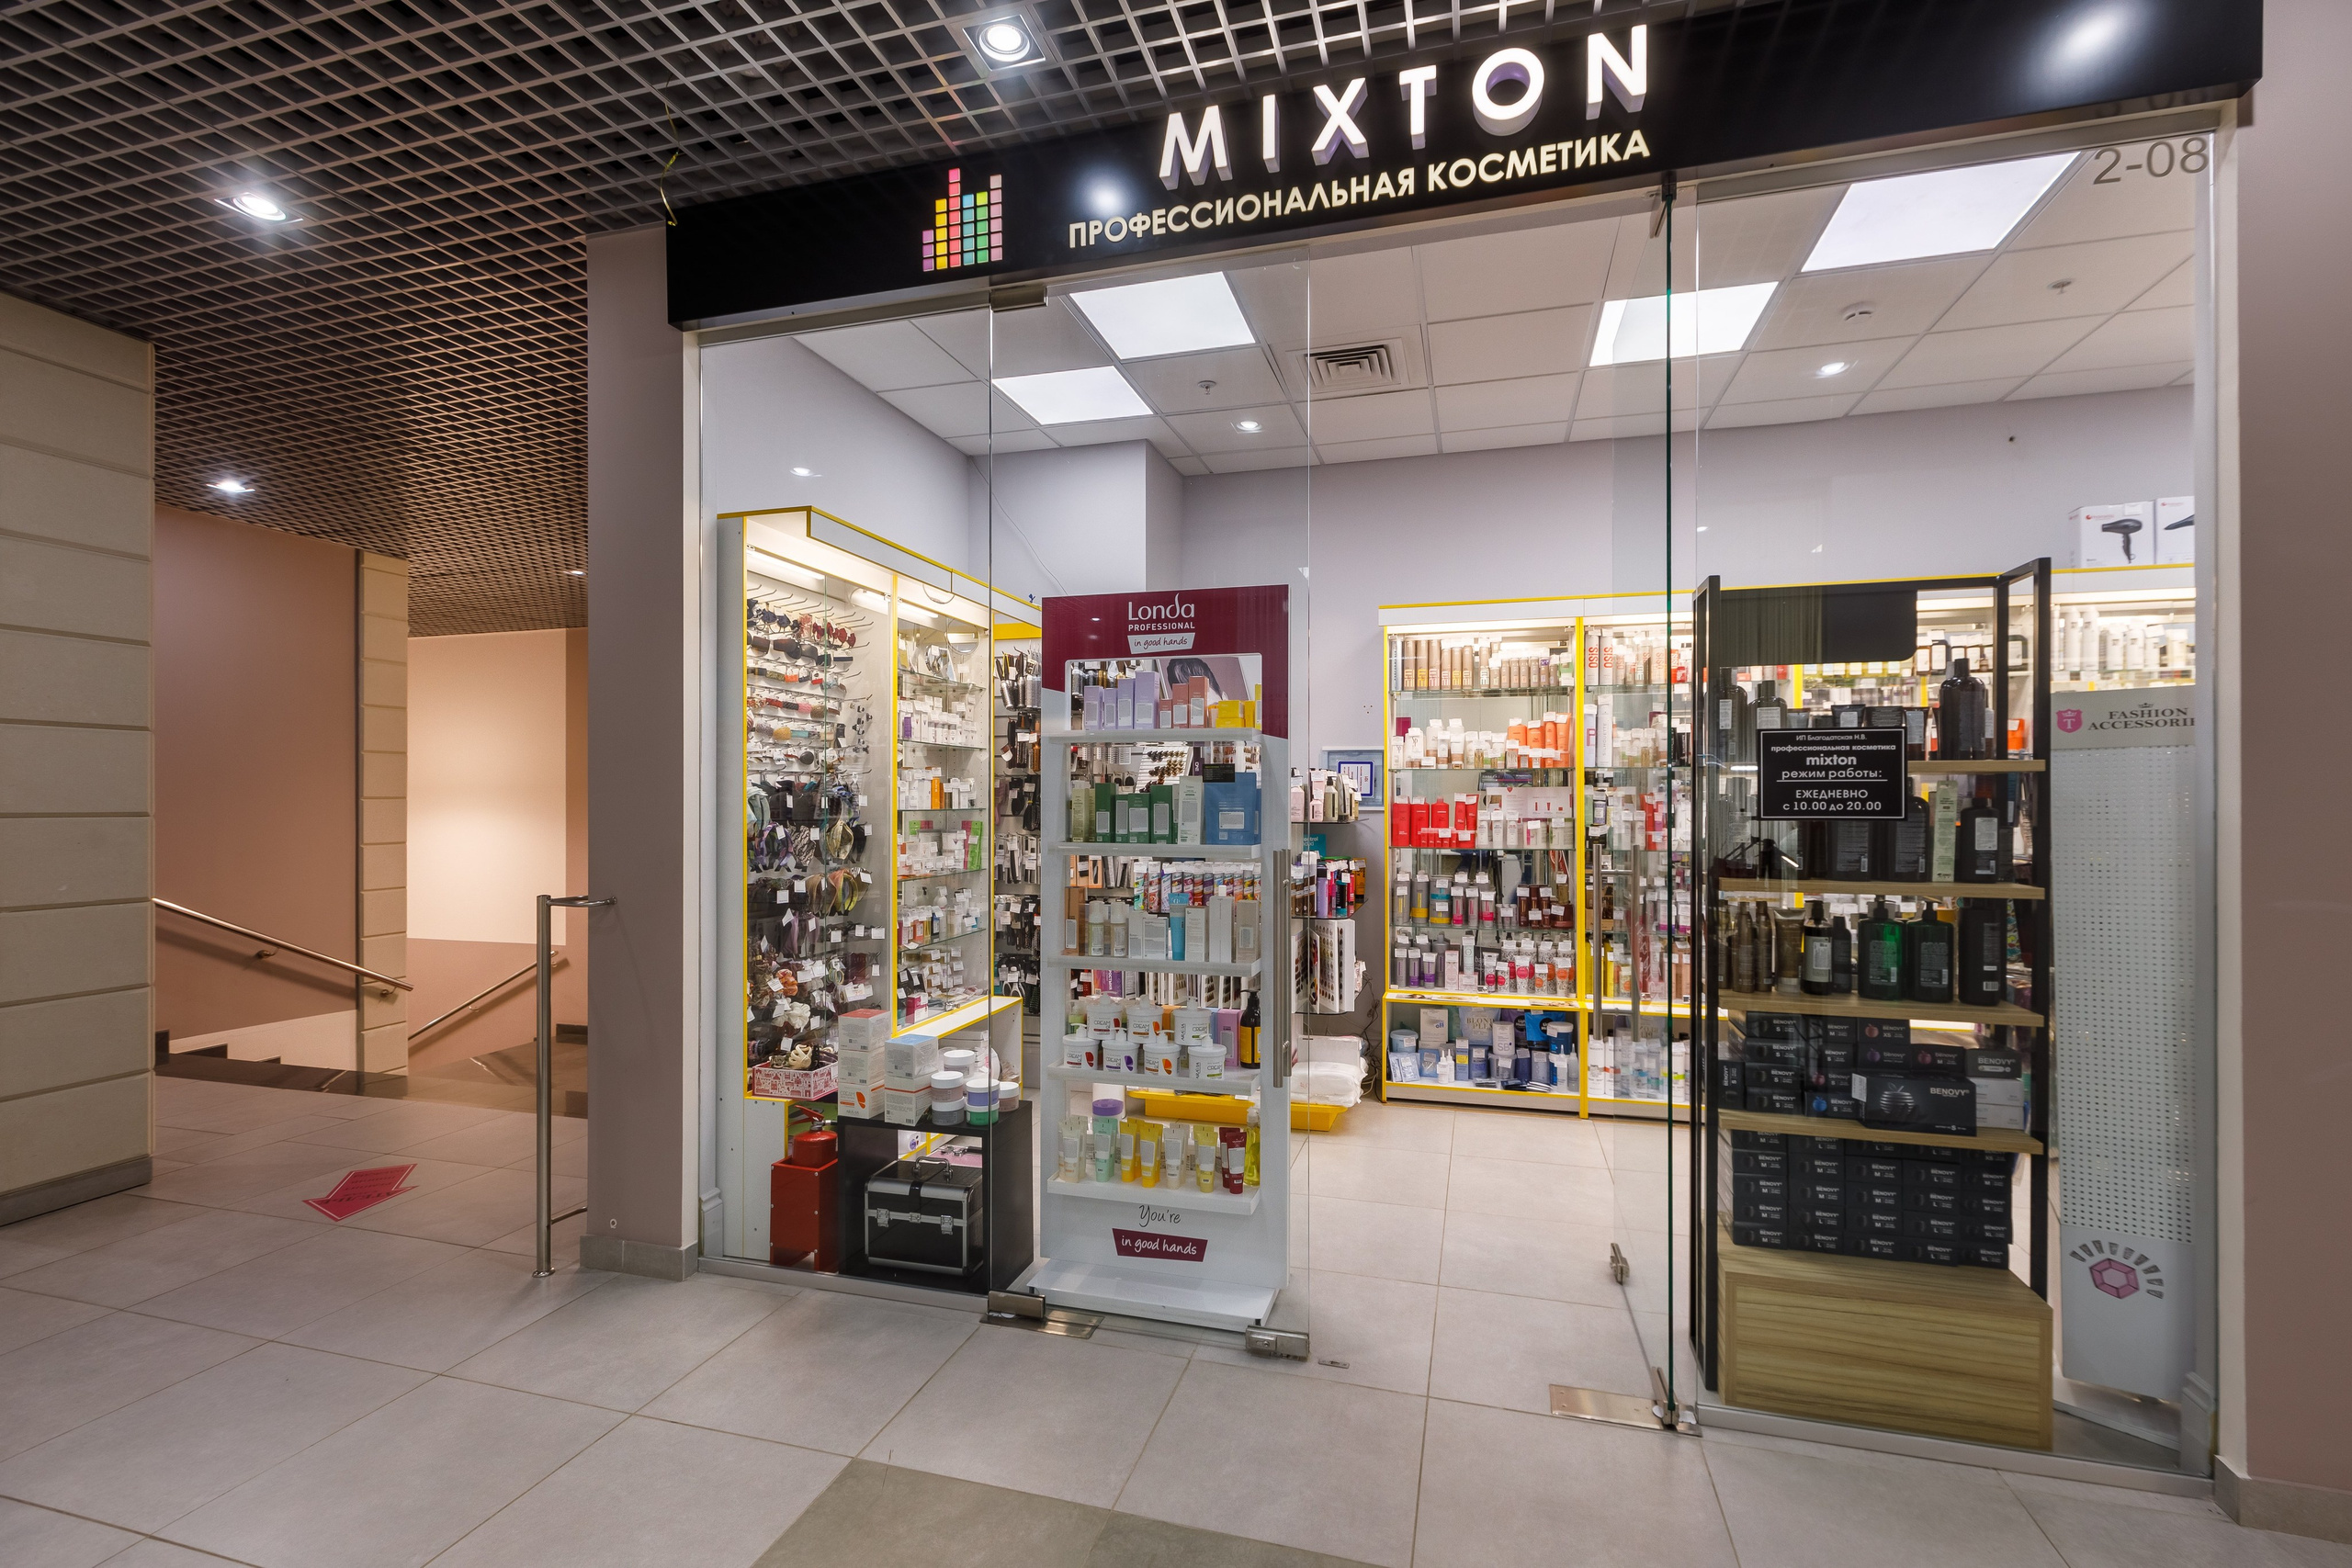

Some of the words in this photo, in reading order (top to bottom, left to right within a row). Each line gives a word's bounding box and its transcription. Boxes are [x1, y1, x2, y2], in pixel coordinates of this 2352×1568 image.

[1159, 25, 1647, 187] MIXTON
[2093, 137, 2209, 185] 2-08
[1069, 166, 1416, 249] ПРОФЕССИОНАЛЬНАЯ
[1427, 130, 1651, 192] КОСМЕТИКА
[1128, 592, 1194, 620] Londa
[1128, 622, 1195, 631] PROFESSIONAL
[1144, 637, 1161, 649] good
[1163, 637, 1188, 646] hands
[2109, 707, 2188, 719] FASHION
[2063, 718, 2075, 729] T
[1770, 744, 1850, 752] профессиональная
[1805, 754, 1857, 765] mixton
[1781, 769, 1826, 780] режим
[1828, 768, 1882, 780] работы:
[1795, 789, 1868, 799] ЕЖЕДНЕВНО
[1793, 801, 1826, 810] 10.00
[1829, 803, 1843, 812] до
[1847, 801, 1882, 810] 20.00
[1139, 1204, 1181, 1227] You're
[1122, 1235, 1132, 1247] in
[1135, 1238, 1159, 1253] good
[1163, 1239, 1196, 1255] hands
